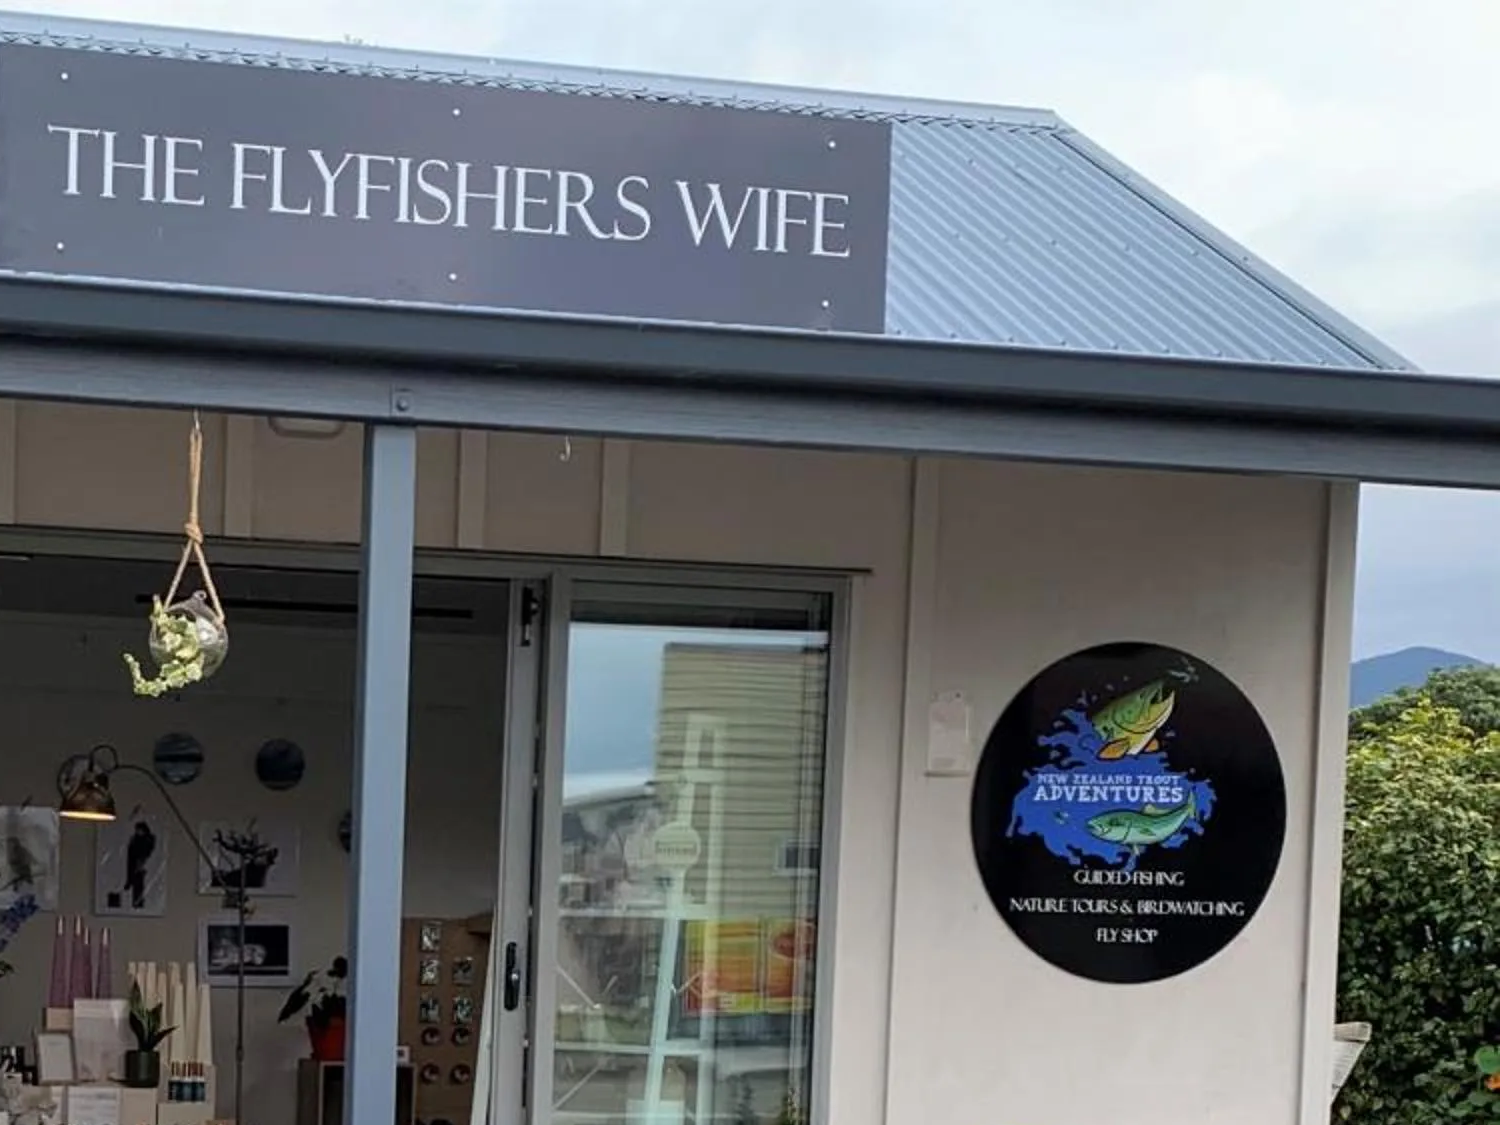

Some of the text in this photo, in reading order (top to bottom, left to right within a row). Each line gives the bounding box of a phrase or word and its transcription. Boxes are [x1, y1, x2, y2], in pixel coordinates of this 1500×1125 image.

[47, 124, 850, 257] THE FLYFISHERS WIFE
[1037, 773, 1183, 785] NEW ZEALAND TROUT
[1033, 785, 1185, 803] ADVENTURES
[1073, 869, 1185, 887] GUIDED FISHING
[1009, 897, 1245, 917] NATURE TOURS & BIRDWATCHING
[1096, 927, 1158, 944] FLY SHOP
